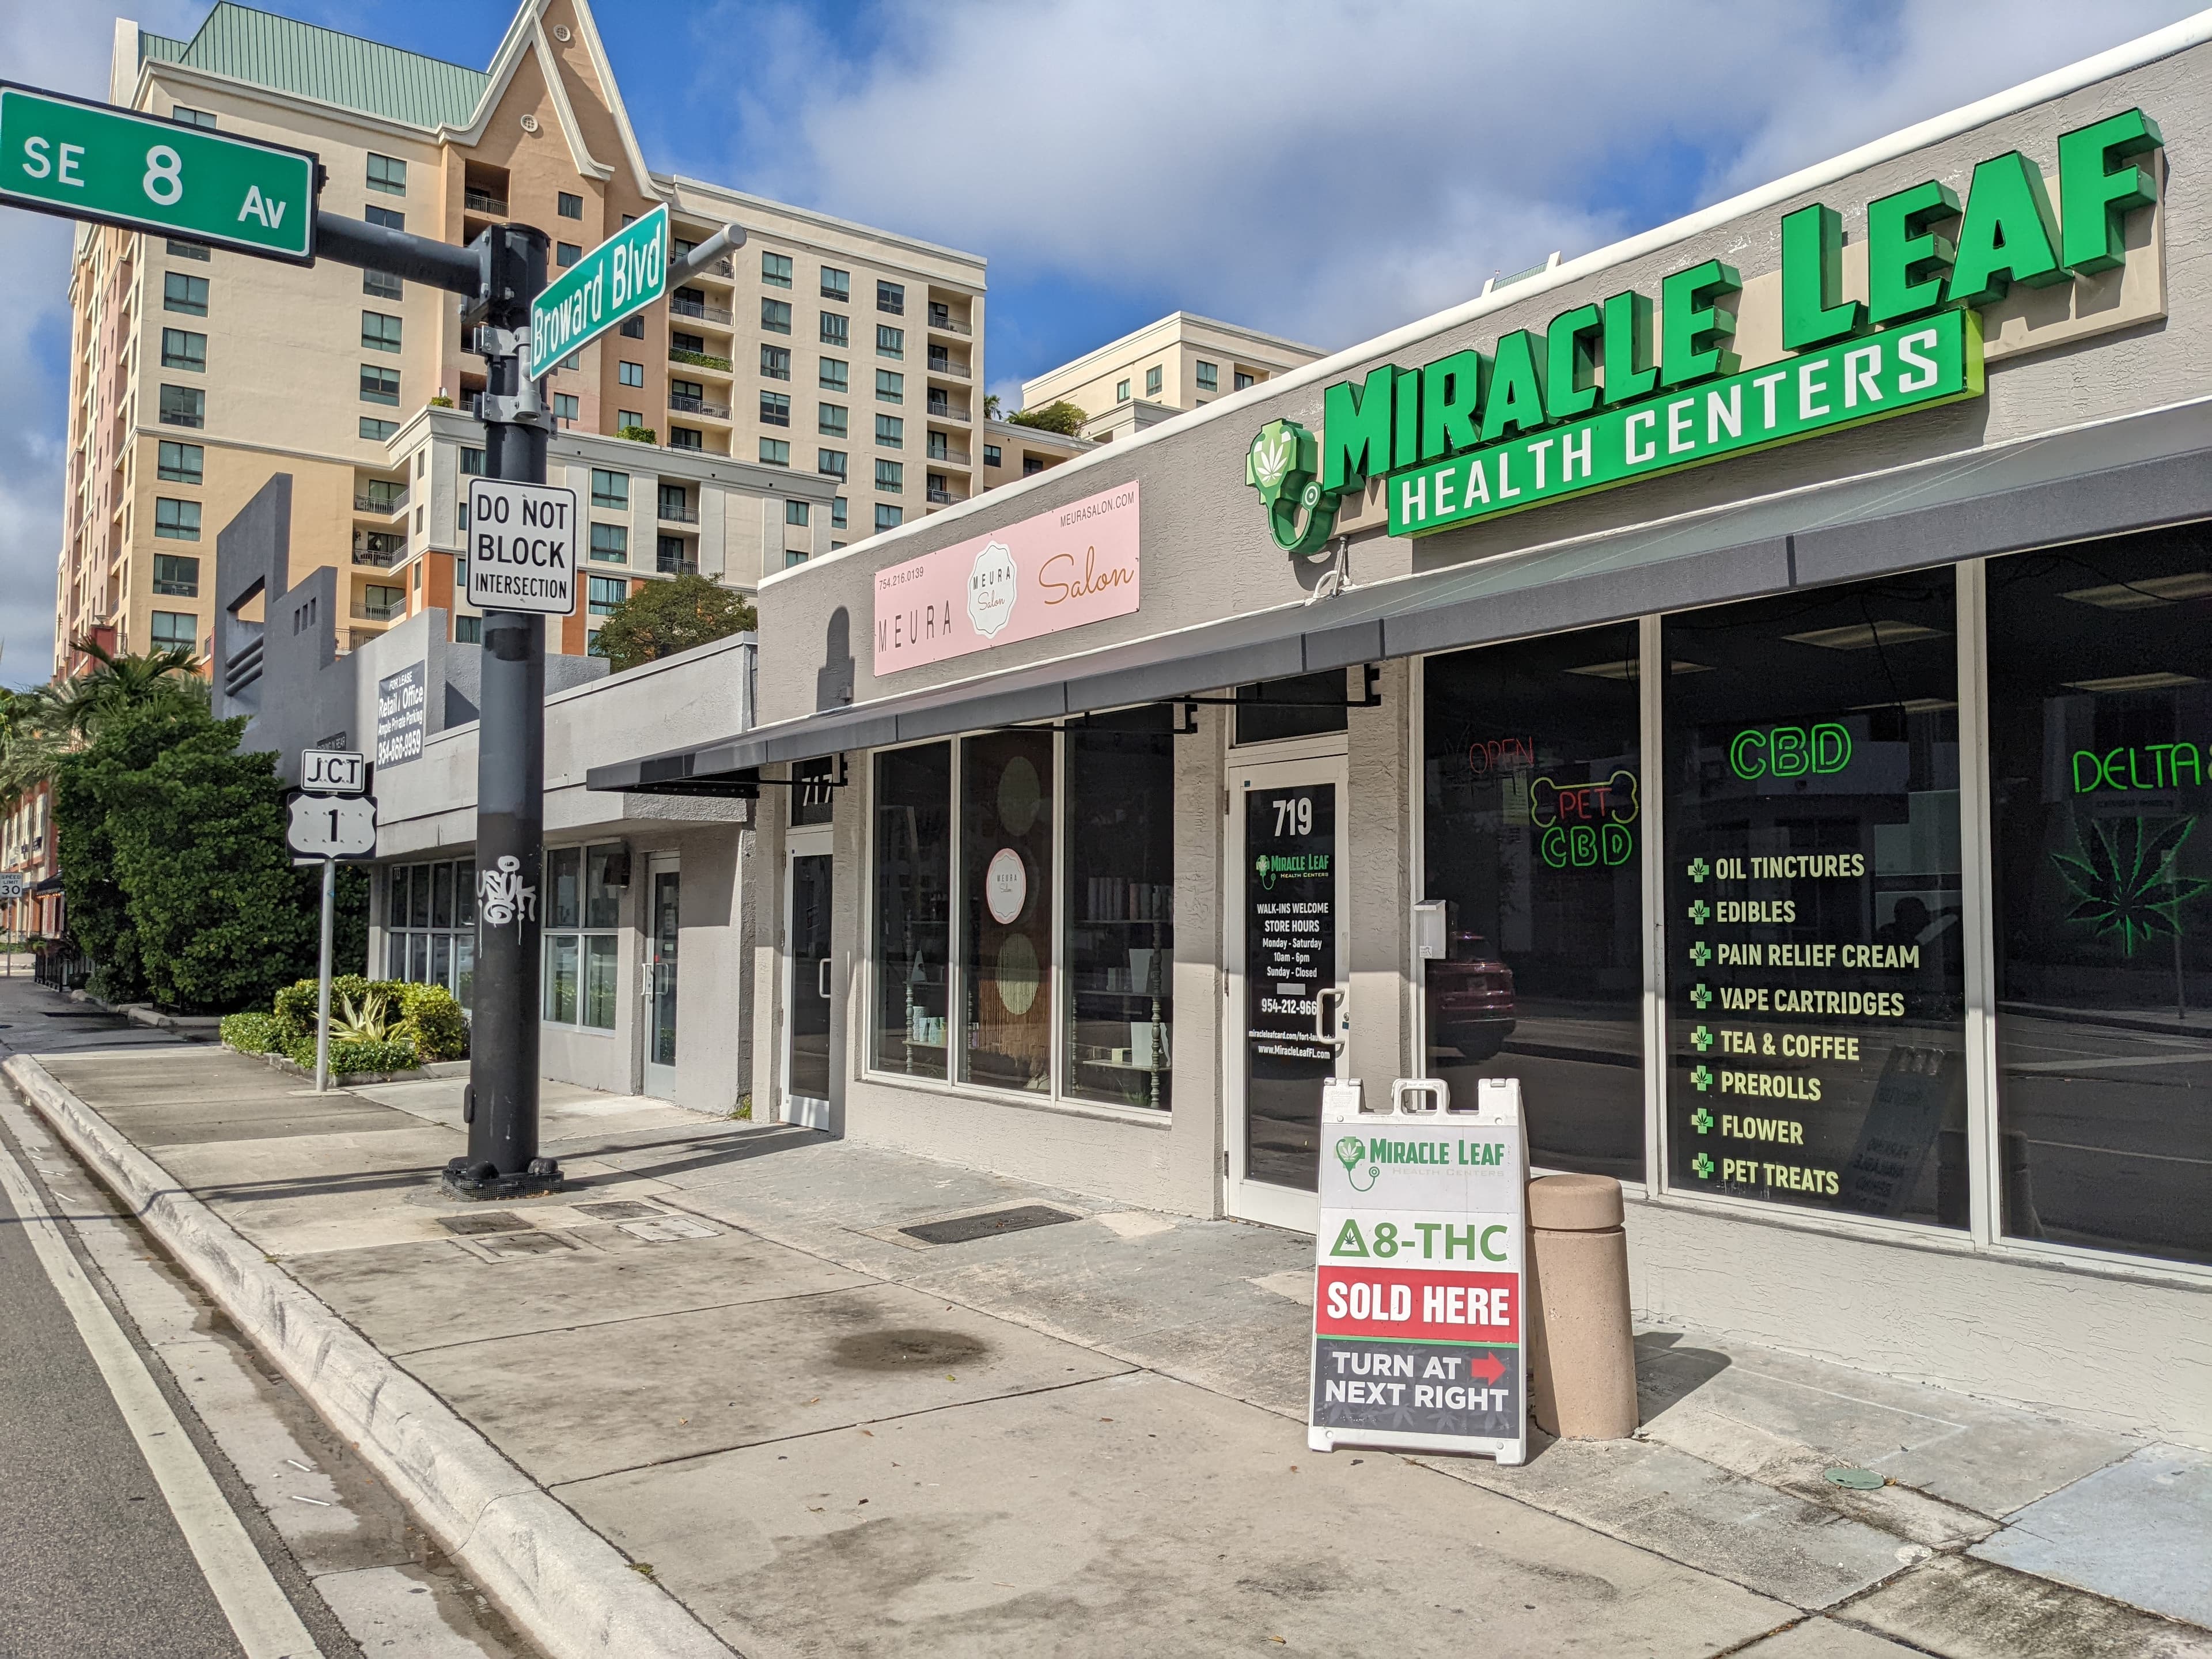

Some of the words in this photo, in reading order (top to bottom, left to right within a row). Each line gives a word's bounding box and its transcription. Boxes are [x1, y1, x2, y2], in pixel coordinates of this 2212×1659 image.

[22, 137, 85, 187] SE
[143, 145, 183, 206] 8
[237, 185, 287, 229] Av
[533, 258, 603, 367] Broward
[612, 221, 661, 310] Blvd
[1324, 258, 1738, 494] MIRACLE
[1781, 107, 2159, 353] LEAF
[1402, 427, 1592, 525] HEALTH
[1625, 328, 1938, 465] CENTERS
[477, 494, 510, 524] DO
[522, 499, 569, 529] NOT
[1060, 491, 1135, 528] MEURASALON.COM
[478, 533, 565, 569] BLOCK
[476, 573, 567, 599] INTERSECTION
[879, 566, 924, 590] 754.216.0139
[973, 565, 1012, 590] MEURA
[1039, 546, 1135, 605] Salon
[978, 592, 1006, 611] Salon
[878, 600, 952, 653] MEURA
[389, 678, 399, 691] FOR
[399, 671, 412, 687] LEASE
[379, 692, 397, 718] Retail
[403, 684, 423, 709] Office
[378, 719, 391, 737] Ample
[392, 715, 406, 731] Private
[406, 709, 423, 725] Parking
[378, 729, 421, 765] 954-866-9959
[1730, 724, 1852, 779] CBD
[307, 757, 360, 783] JCT
[2073, 743, 2201, 793] DELTA
[801, 774, 832, 806] 717
[1559, 787, 1612, 820] PET
[328, 809, 339, 842] 1
[1272, 797, 1313, 836] 719
[1541, 824, 1633, 868] CBD
[1271, 855, 1306, 872] MIRACLE
[1308, 853, 1330, 870] LEAF
[1716, 858, 1747, 879] OIL
[1751, 853, 1865, 879] TINCTURES
[2, 885, 20, 895] 30
[1257, 903, 1291, 914] WALK-INS
[1292, 903, 1329, 914] WELCOME
[1717, 900, 1796, 923] EDIBLES
[1264, 920, 1290, 932] STORE
[1291, 920, 1320, 932] HOURS
[1263, 938, 1287, 950] Monday
[1292, 938, 1322, 950] Saturday
[1274, 952, 1290, 962] 10am
[1296, 952, 1310, 964] 6pm
[1718, 944, 1762, 965] PAIN
[1768, 944, 1836, 967] RELIEF
[1843, 945, 1919, 968] CREAM
[1267, 967, 1290, 979] Sunday
[1295, 967, 1317, 978] Closed
[1262, 998, 1323, 1015] 954-212-966
[1720, 987, 1769, 1010] VAPE
[1774, 989, 1905, 1016] CARTRIDGES
[1258, 1045, 1331, 1059] www.MiracleLeafFL.com
[1721, 1031, 1757, 1054] TEA
[1763, 1033, 1777, 1055] &
[1782, 1034, 1859, 1060] COFFEE
[1721, 1071, 1821, 1101] PREROLLS
[1722, 1115, 1804, 1145] FLOWER
[1370, 1138, 1450, 1165] MIRACLE
[1459, 1139, 1505, 1166] LEAF
[1392, 1166, 1440, 1176] HEALTH
[1446, 1168, 1505, 1177] CENTERS
[1723, 1158, 1759, 1183] PET
[1763, 1162, 1839, 1195] TREATS
[1327, 1281, 1411, 1321] SOLD
[1423, 1286, 1510, 1325] HERE
[1332, 1351, 1414, 1377] TURN
[1422, 1356, 1462, 1380] AT
[1325, 1380, 1406, 1406] NEXT
[1415, 1384, 1509, 1411] RIGHT
